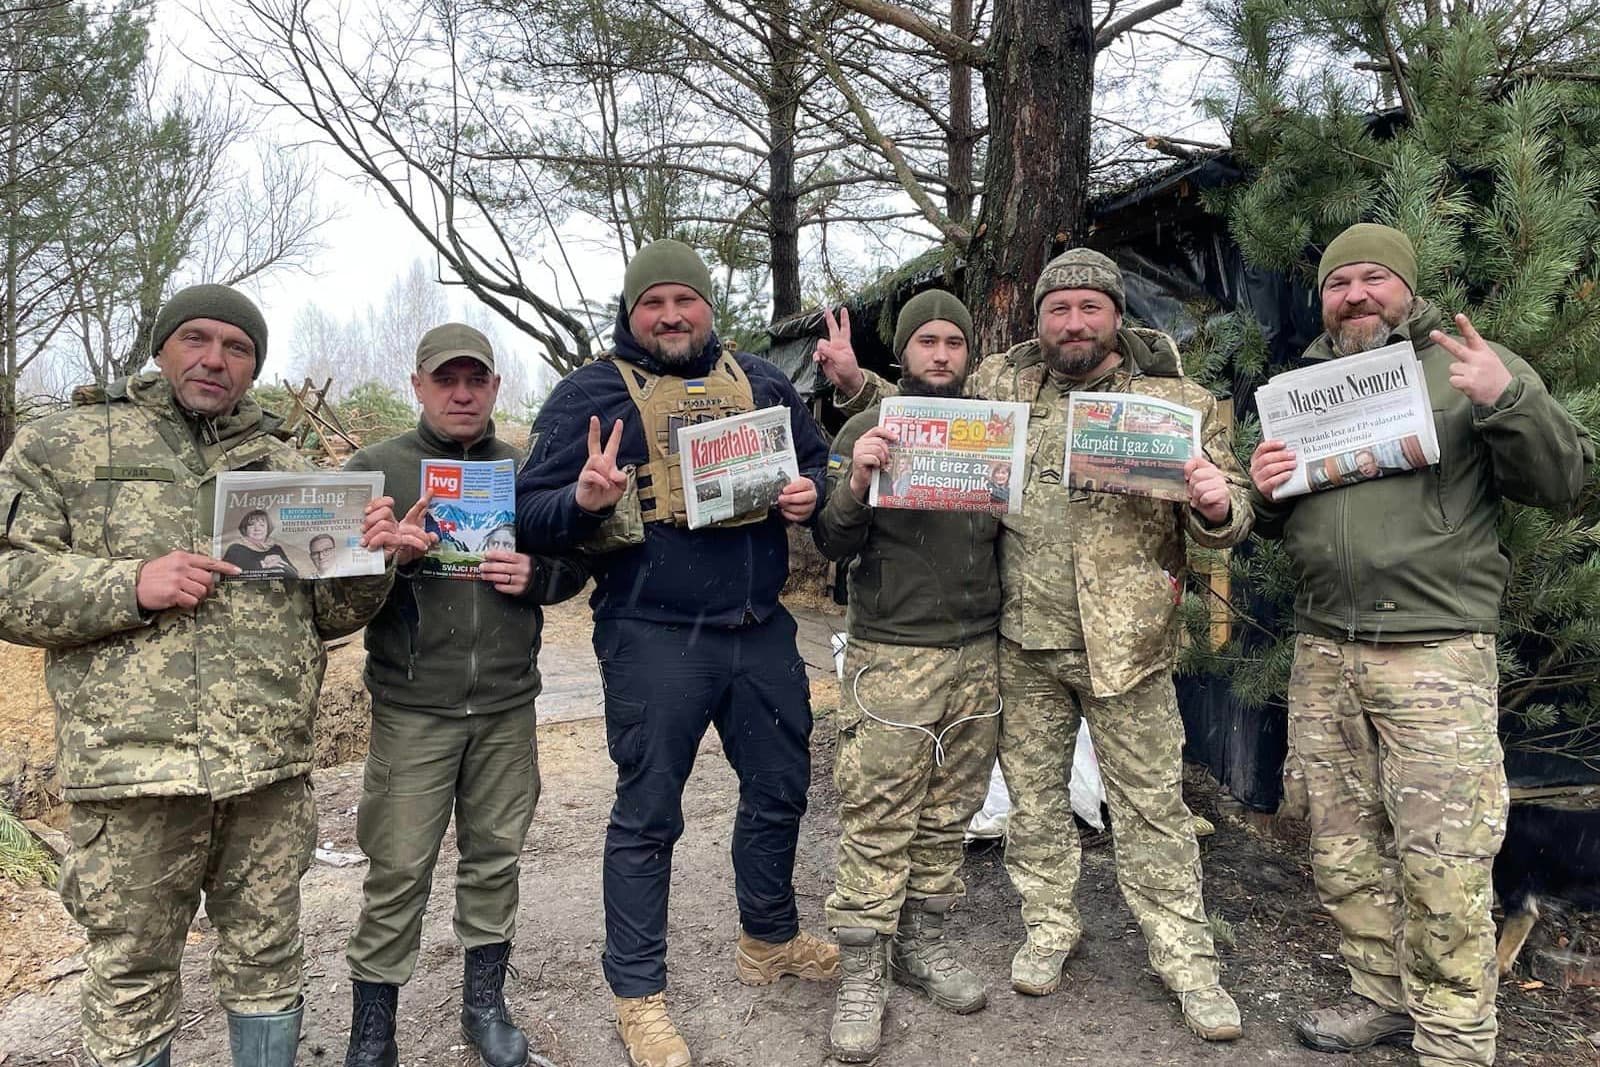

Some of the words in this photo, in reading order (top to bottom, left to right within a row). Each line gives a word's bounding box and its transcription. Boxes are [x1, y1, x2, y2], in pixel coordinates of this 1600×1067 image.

[1287, 384, 1345, 416] Magyar
[1346, 363, 1409, 401] Nemzet
[691, 424, 759, 468] Kárpátalja
[1073, 432, 1118, 453] Kárpáti
[1122, 437, 1148, 455] Igaz
[1151, 438, 1174, 456] Szó
[1300, 430, 1331, 446] Hazánk
[1331, 428, 1345, 439] lesz
[1347, 425, 1355, 434] az
[912, 455, 935, 471] Mit
[940, 457, 969, 475] érez
[973, 464, 989, 476] az
[429, 472, 458, 491] hvg
[910, 470, 993, 493] édesanyjuk,
[229, 493, 294, 510] Magyar
[301, 487, 346, 507] Hang
[442, 563, 468, 573] SVÁJCI
